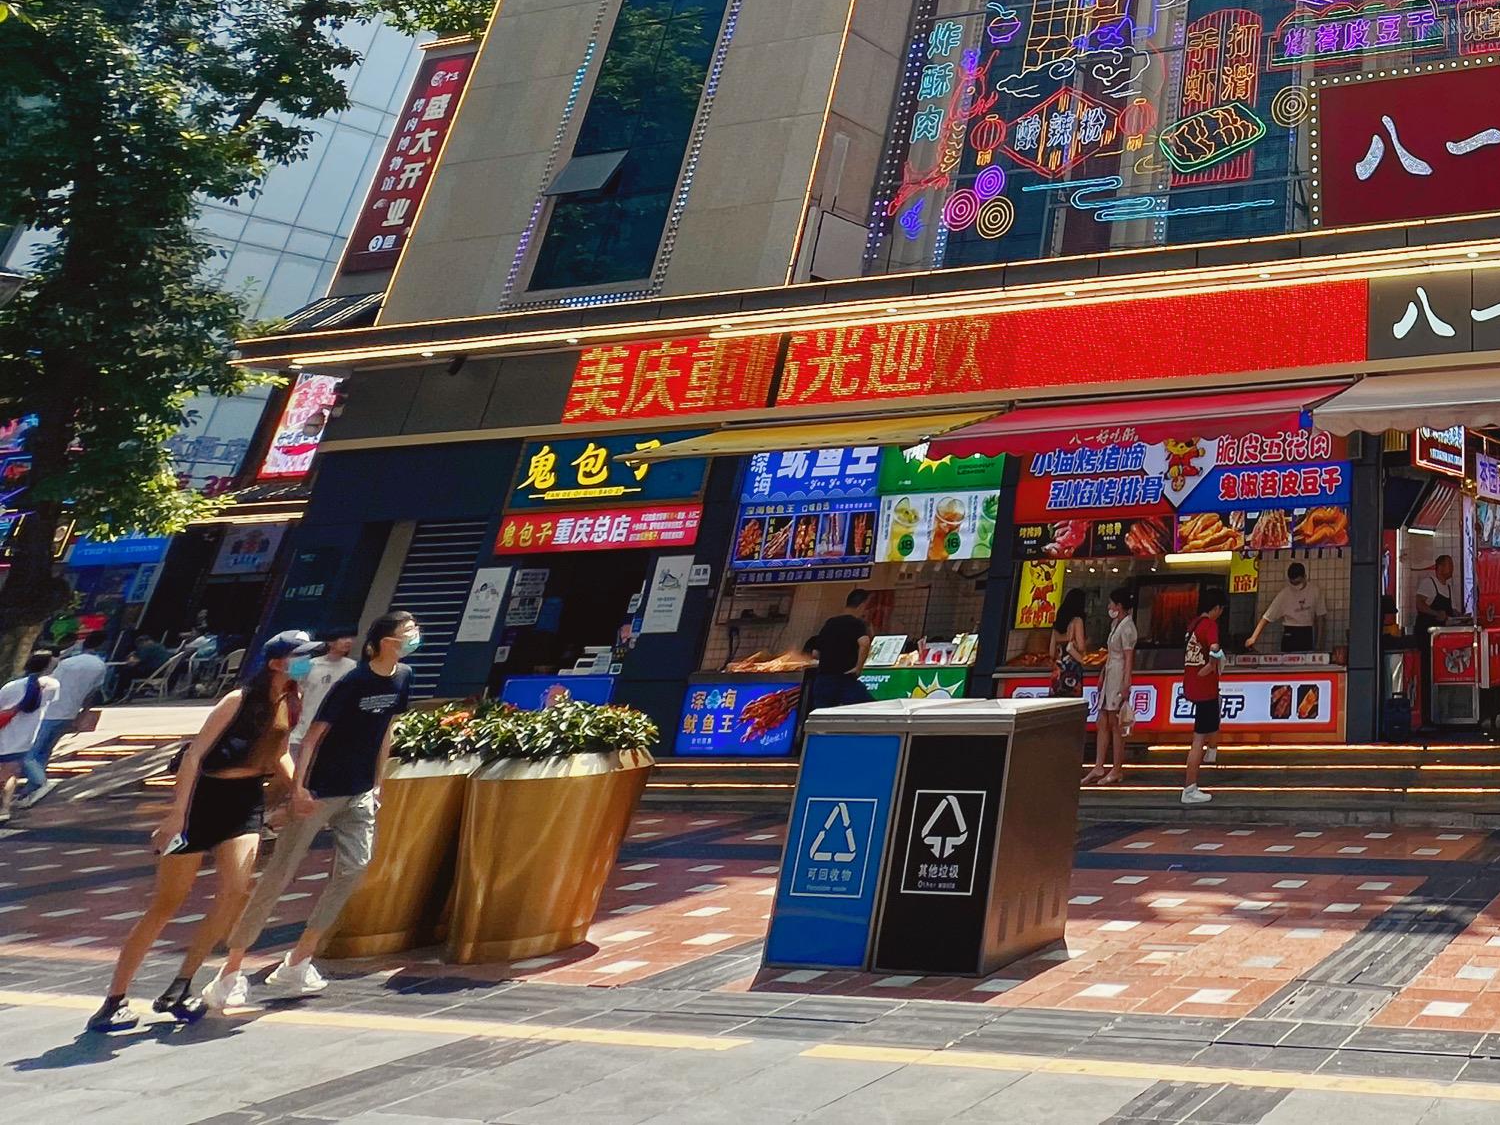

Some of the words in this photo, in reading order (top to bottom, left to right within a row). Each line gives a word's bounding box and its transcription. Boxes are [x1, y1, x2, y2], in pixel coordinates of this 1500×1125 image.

[911, 21, 963, 144] 炸酥肉
[382, 93, 453, 228] 盛大开业
[750, 452, 773, 496] 深海
[551, 514, 632, 545] 重庆总店
[807, 867, 852, 882] 可回收物
[917, 863, 959, 880] 其他垃圾
